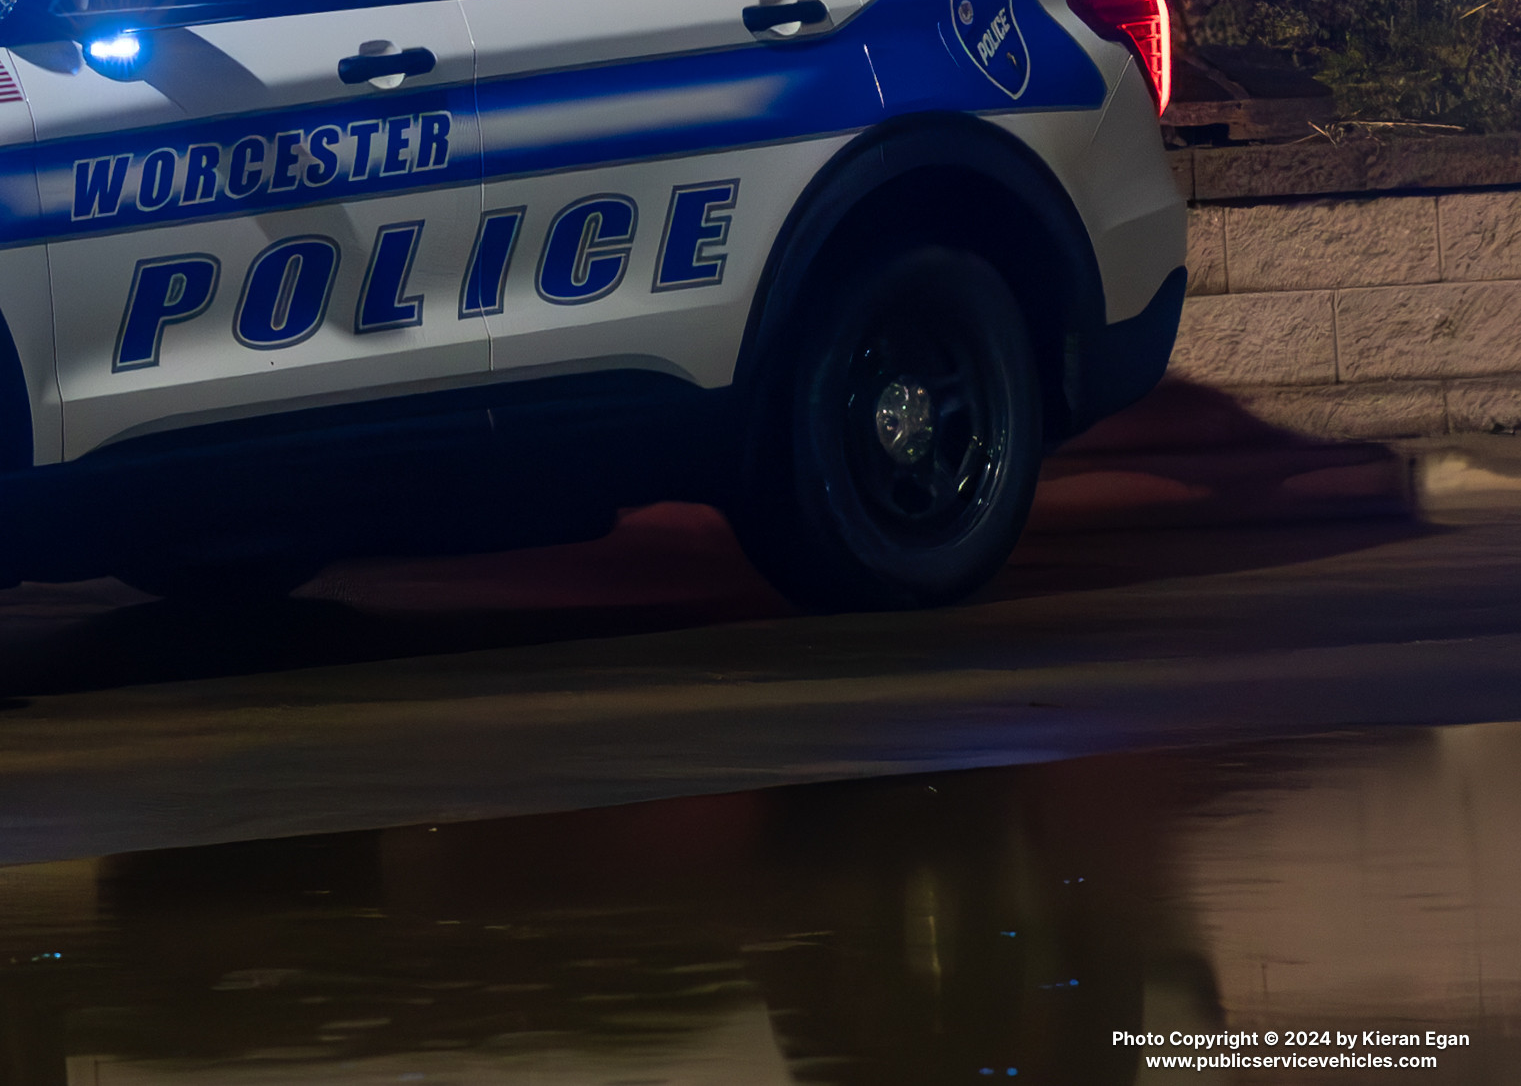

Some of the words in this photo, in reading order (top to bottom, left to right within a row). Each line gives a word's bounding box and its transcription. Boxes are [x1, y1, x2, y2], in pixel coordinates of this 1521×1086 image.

[976, 7, 1011, 66] POLICE
[70, 110, 453, 221] WORCESTER
[110, 178, 741, 374] POLICE
